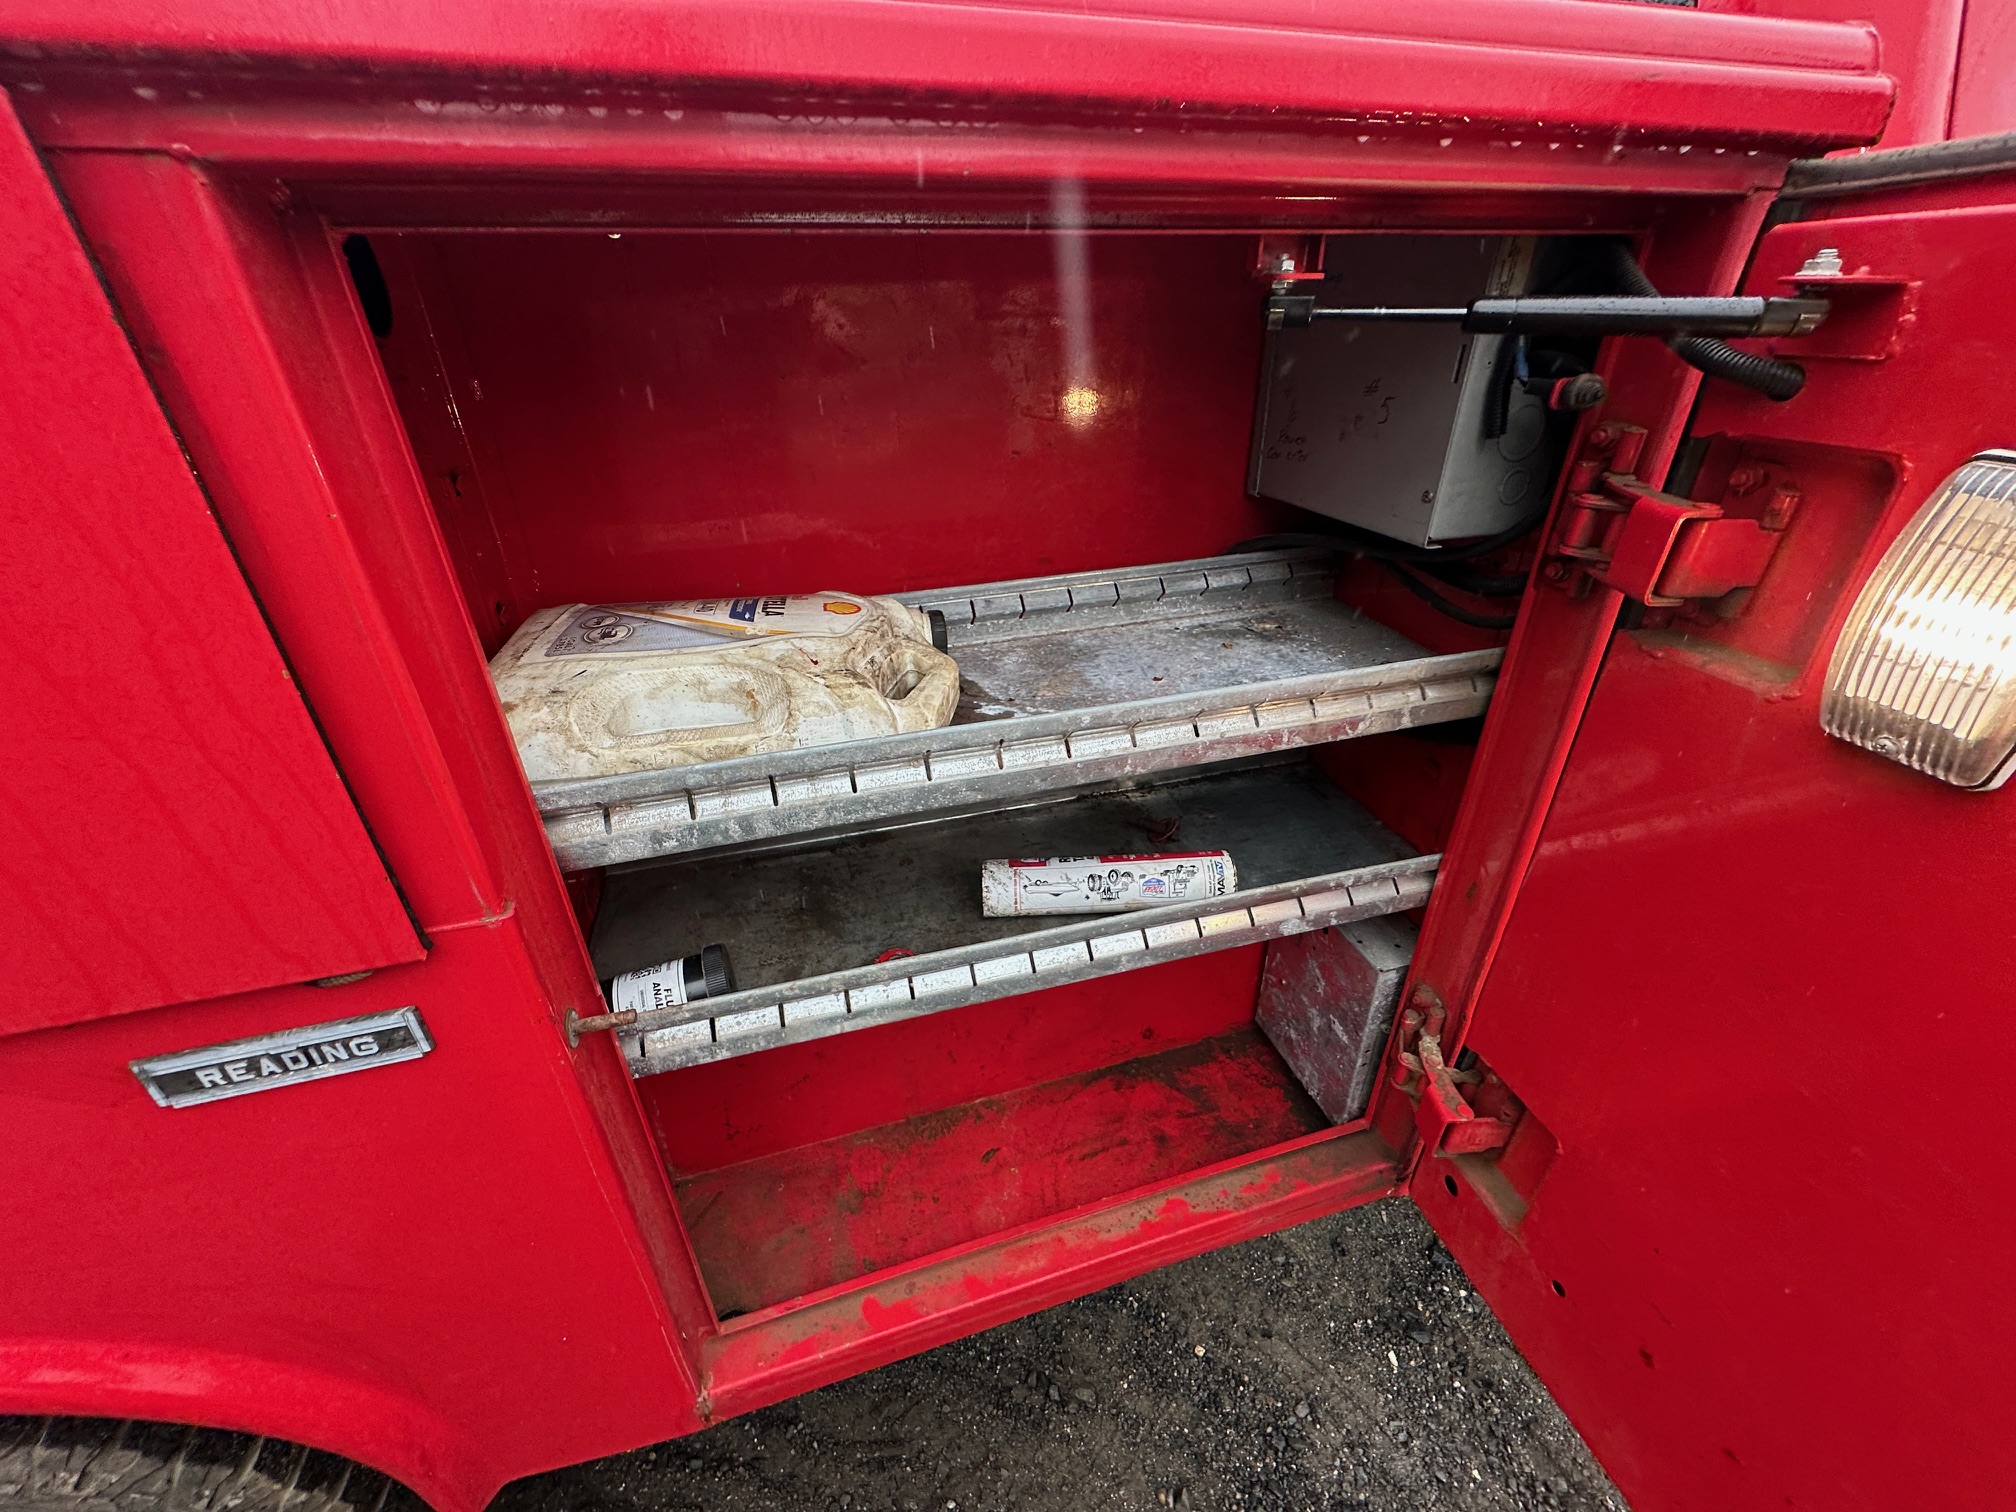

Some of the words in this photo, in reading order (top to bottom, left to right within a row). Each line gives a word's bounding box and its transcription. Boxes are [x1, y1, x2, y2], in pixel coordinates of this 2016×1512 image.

[1377, 396, 1397, 425] 5
[762, 596, 788, 617] TELLA
[653, 982, 664, 1009] ANAL
[664, 988, 674, 1007] FLU
[195, 1035, 380, 1088] READING
